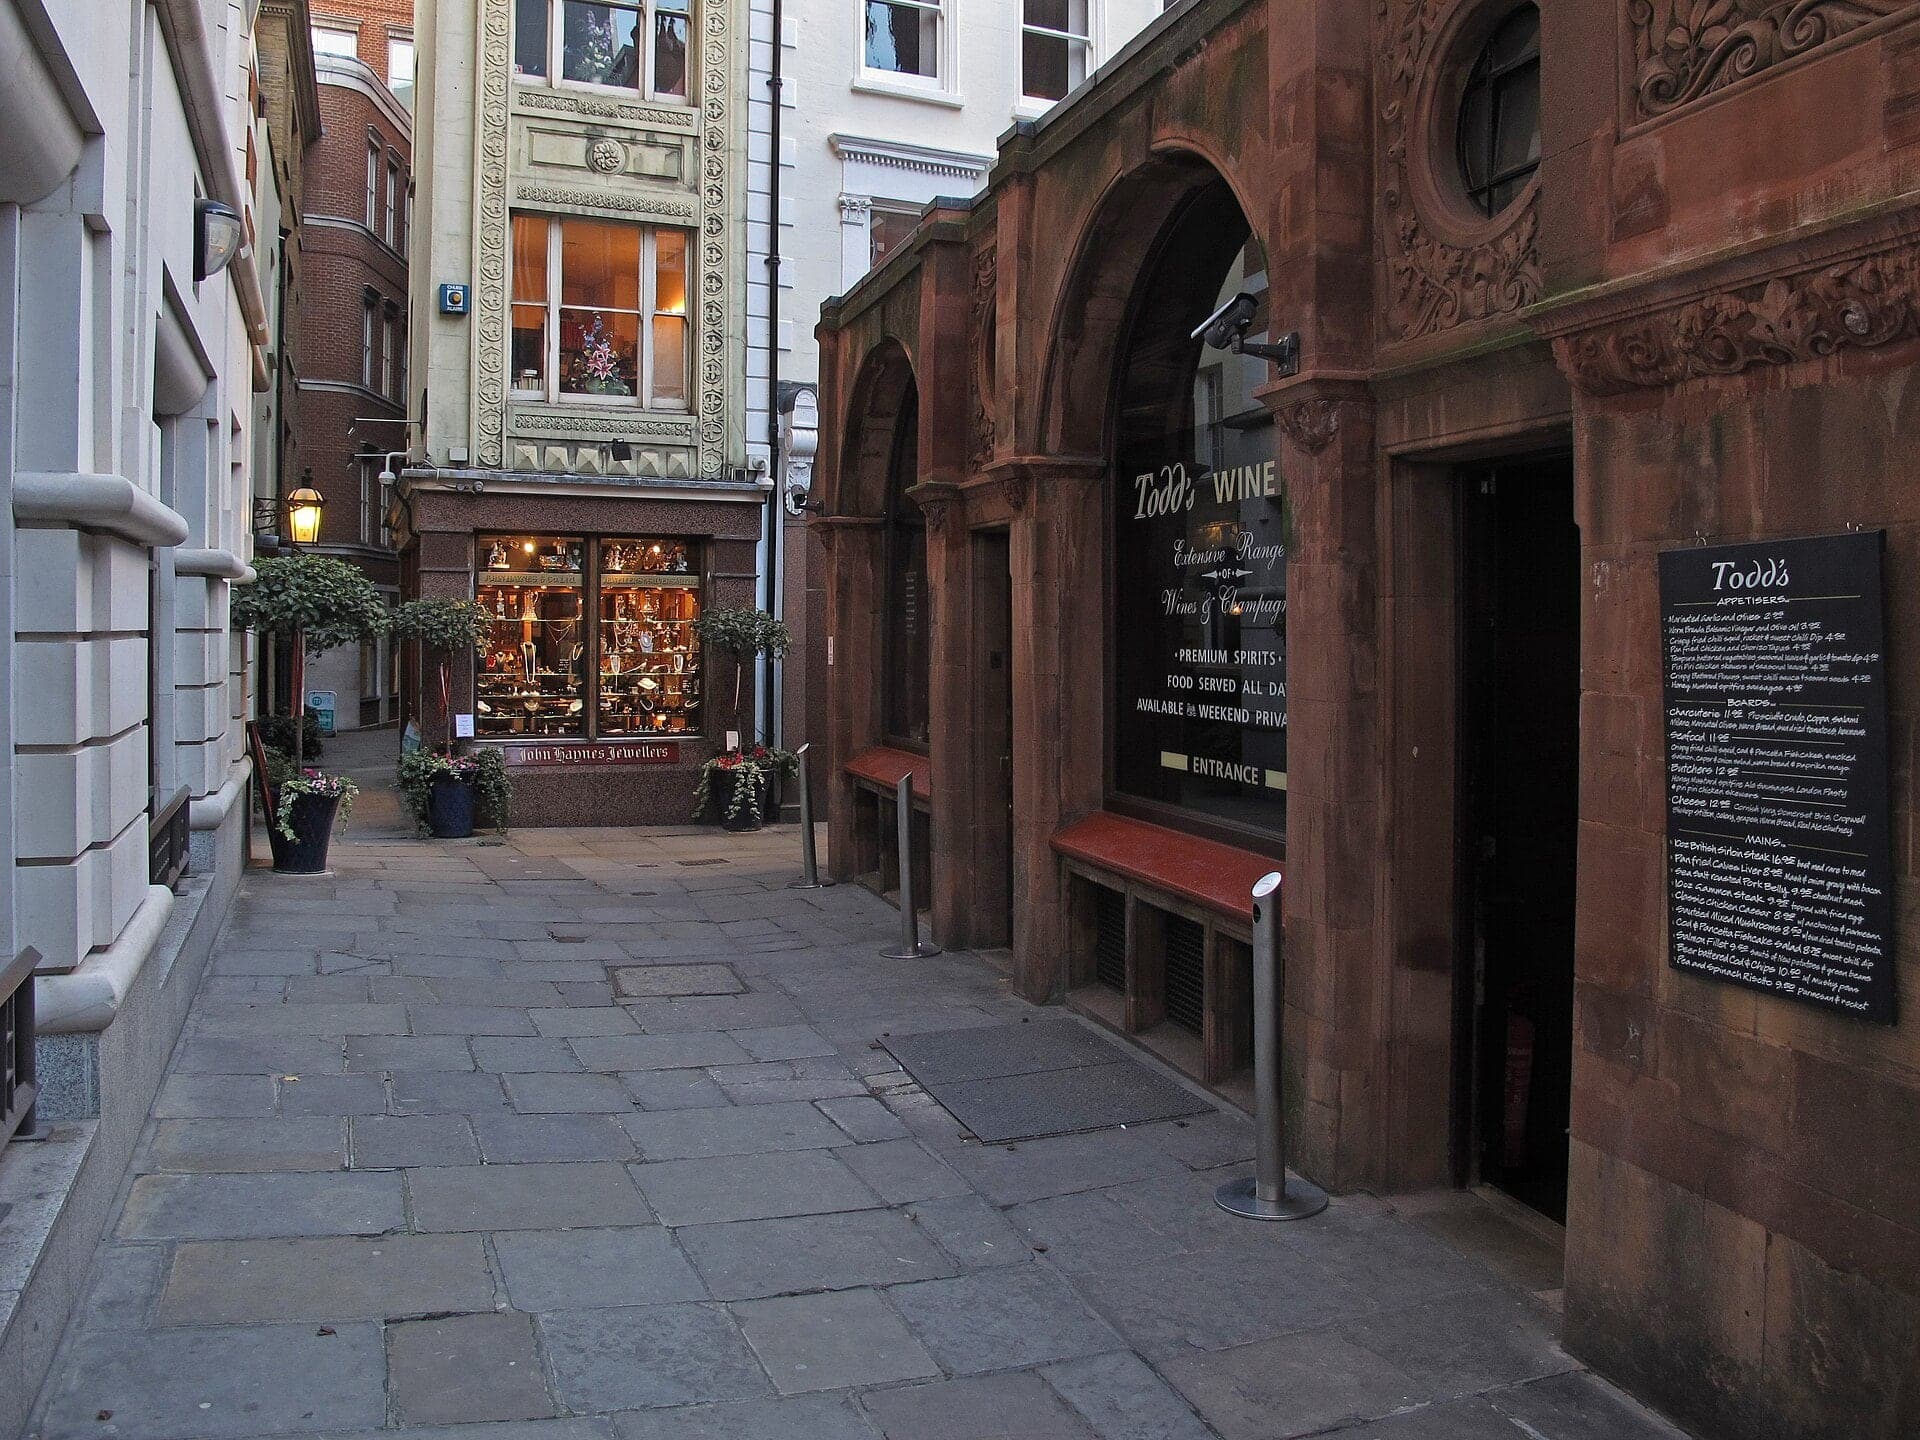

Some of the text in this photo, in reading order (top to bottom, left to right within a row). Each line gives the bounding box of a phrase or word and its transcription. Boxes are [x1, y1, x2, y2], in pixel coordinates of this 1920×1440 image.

[1134, 460, 1275, 520] Todd's WINE
[1173, 532, 1286, 570] Extensive Range
[1712, 558, 1790, 590] Todd's
[1162, 588, 1197, 615] Wines
[1200, 592, 1215, 624] &
[1167, 674, 1287, 697] FOOD SERVED ALL DA
[1137, 698, 1184, 716] AVAILABLE
[1199, 704, 1249, 723] WEEKEND
[1670, 707, 1720, 718] Charcuterie
[1670, 730, 1705, 741] Seafood
[519, 746, 668, 763] John Haynes Jewellers
[1194, 756, 1259, 785] ENTRANCE
[1671, 763, 1713, 774] Butchers
[1672, 796, 1707, 806] Cheese
[1690, 841, 1717, 854] British
[1744, 850, 1770, 862] Steak
[1675, 854, 1691, 864] Pan
[1692, 856, 1712, 867] fried
[1741, 864, 1762, 876] Liver
[1675, 868, 1692, 877] Sea
[1711, 873, 1742, 884] roasted
[1742, 877, 1763, 888] Pork
[1764, 882, 1790, 898] Belly
[1675, 890, 1706, 905] Classic
[1706, 898, 1738, 912] Chicken
[1739, 905, 1772, 917] Caesar
[1695, 883, 1733, 897] Gammon
[1734, 890, 1765, 903] Steak
[1791, 901, 1814, 914] topped
[1828, 909, 1847, 919] fried
[1848, 914, 1865, 925] egg
[1711, 912, 1734, 924] Mixed
[1734, 915, 1781, 931] Mushrooms
[1676, 930, 1705, 944] Salmon
[1706, 937, 1729, 949] Fillet
[1676, 918, 1692, 927] Cod
[1699, 923, 1733, 937] Pancetta
[1734, 930, 1773, 945] Fishcake
[1861, 960, 1874, 969] dip
[1677, 943, 1697, 955] Beer
[1698, 948, 1729, 963] battered
[1729, 955, 1745, 967] Cod
[1751, 960, 1776, 974] Chips
[1677, 954, 1690, 965] Pea
[1692, 961, 1706, 969] and
[1744, 972, 1772, 986] Risotto
[1841, 998, 1869, 1010] rocket
